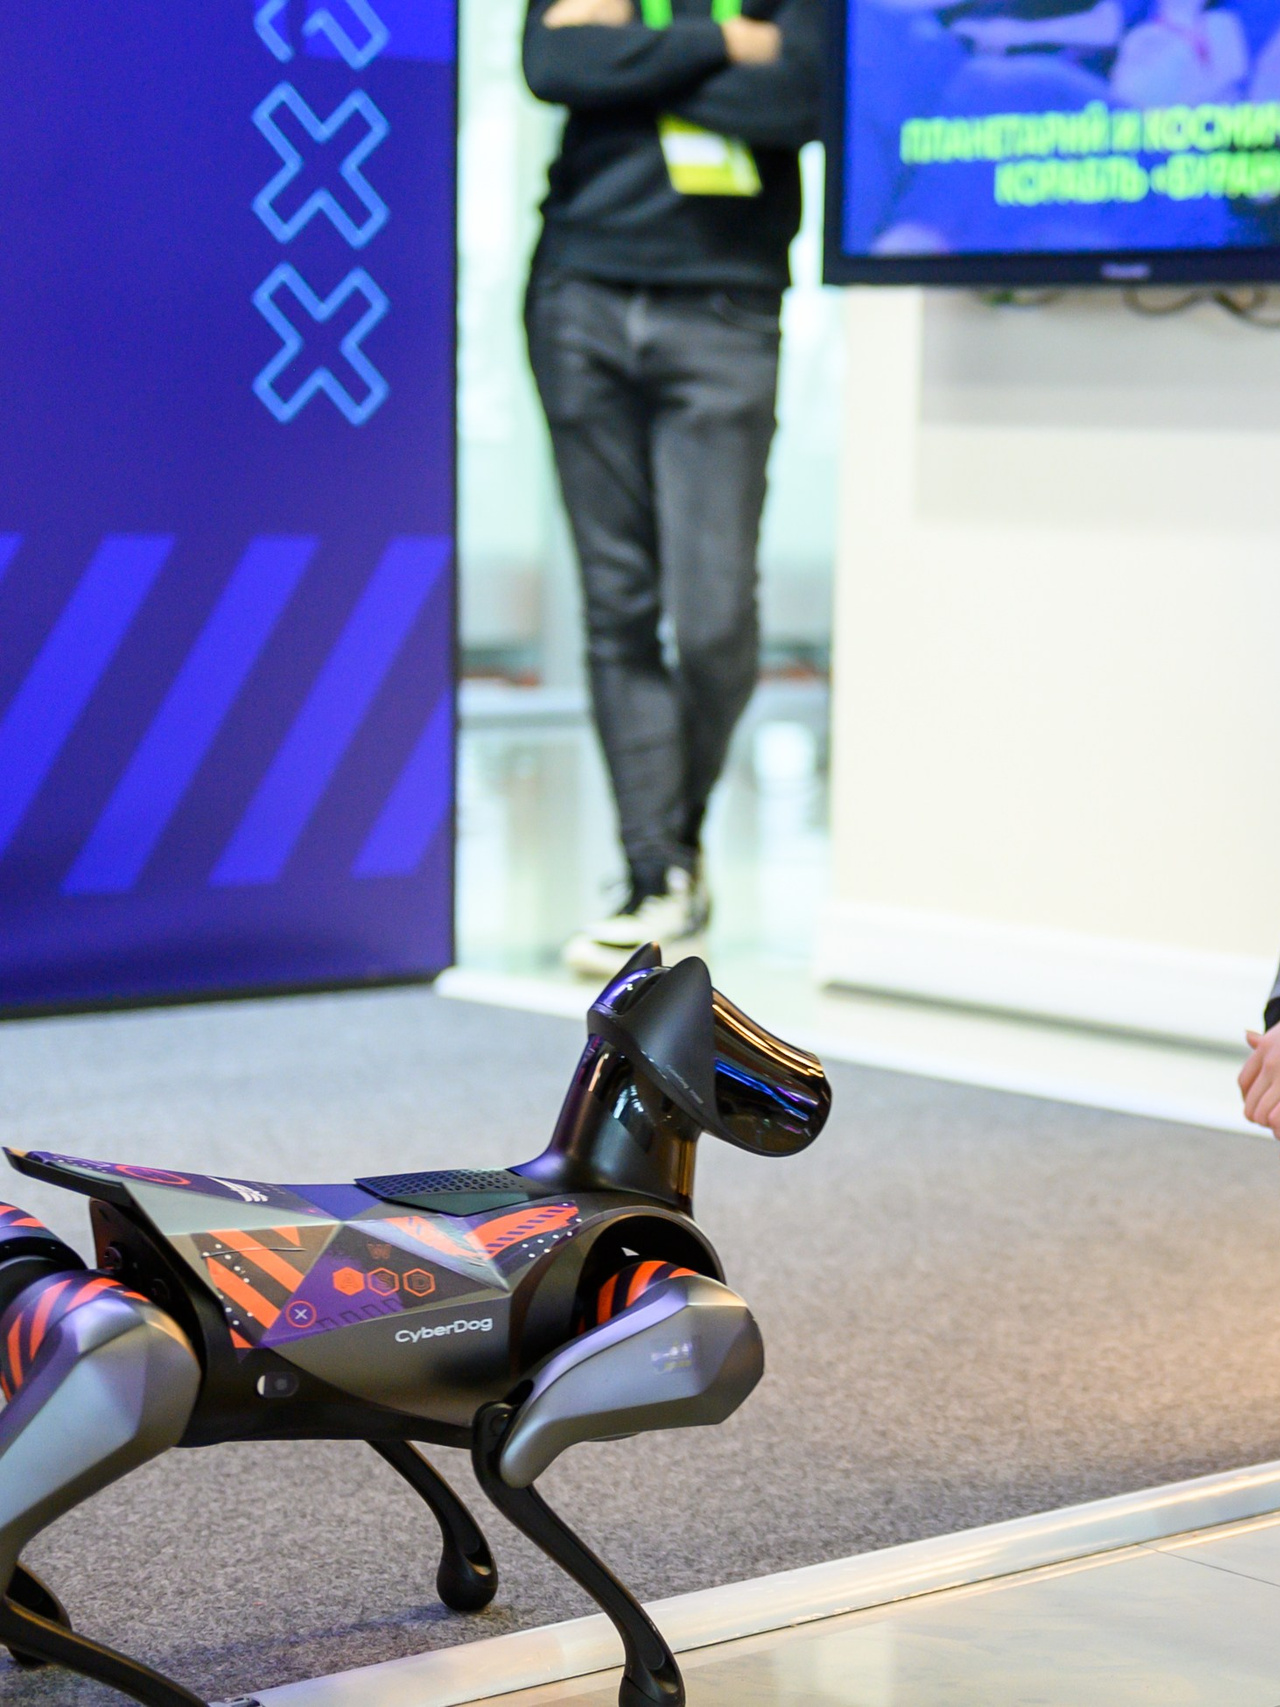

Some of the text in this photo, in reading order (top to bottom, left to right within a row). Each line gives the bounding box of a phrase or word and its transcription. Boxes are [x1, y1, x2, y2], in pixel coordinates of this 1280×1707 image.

[900, 101, 1108, 164] ПЛАНЕТАРИЙ
[1112, 110, 1141, 152] И
[395, 1318, 493, 1343] CyberDog
